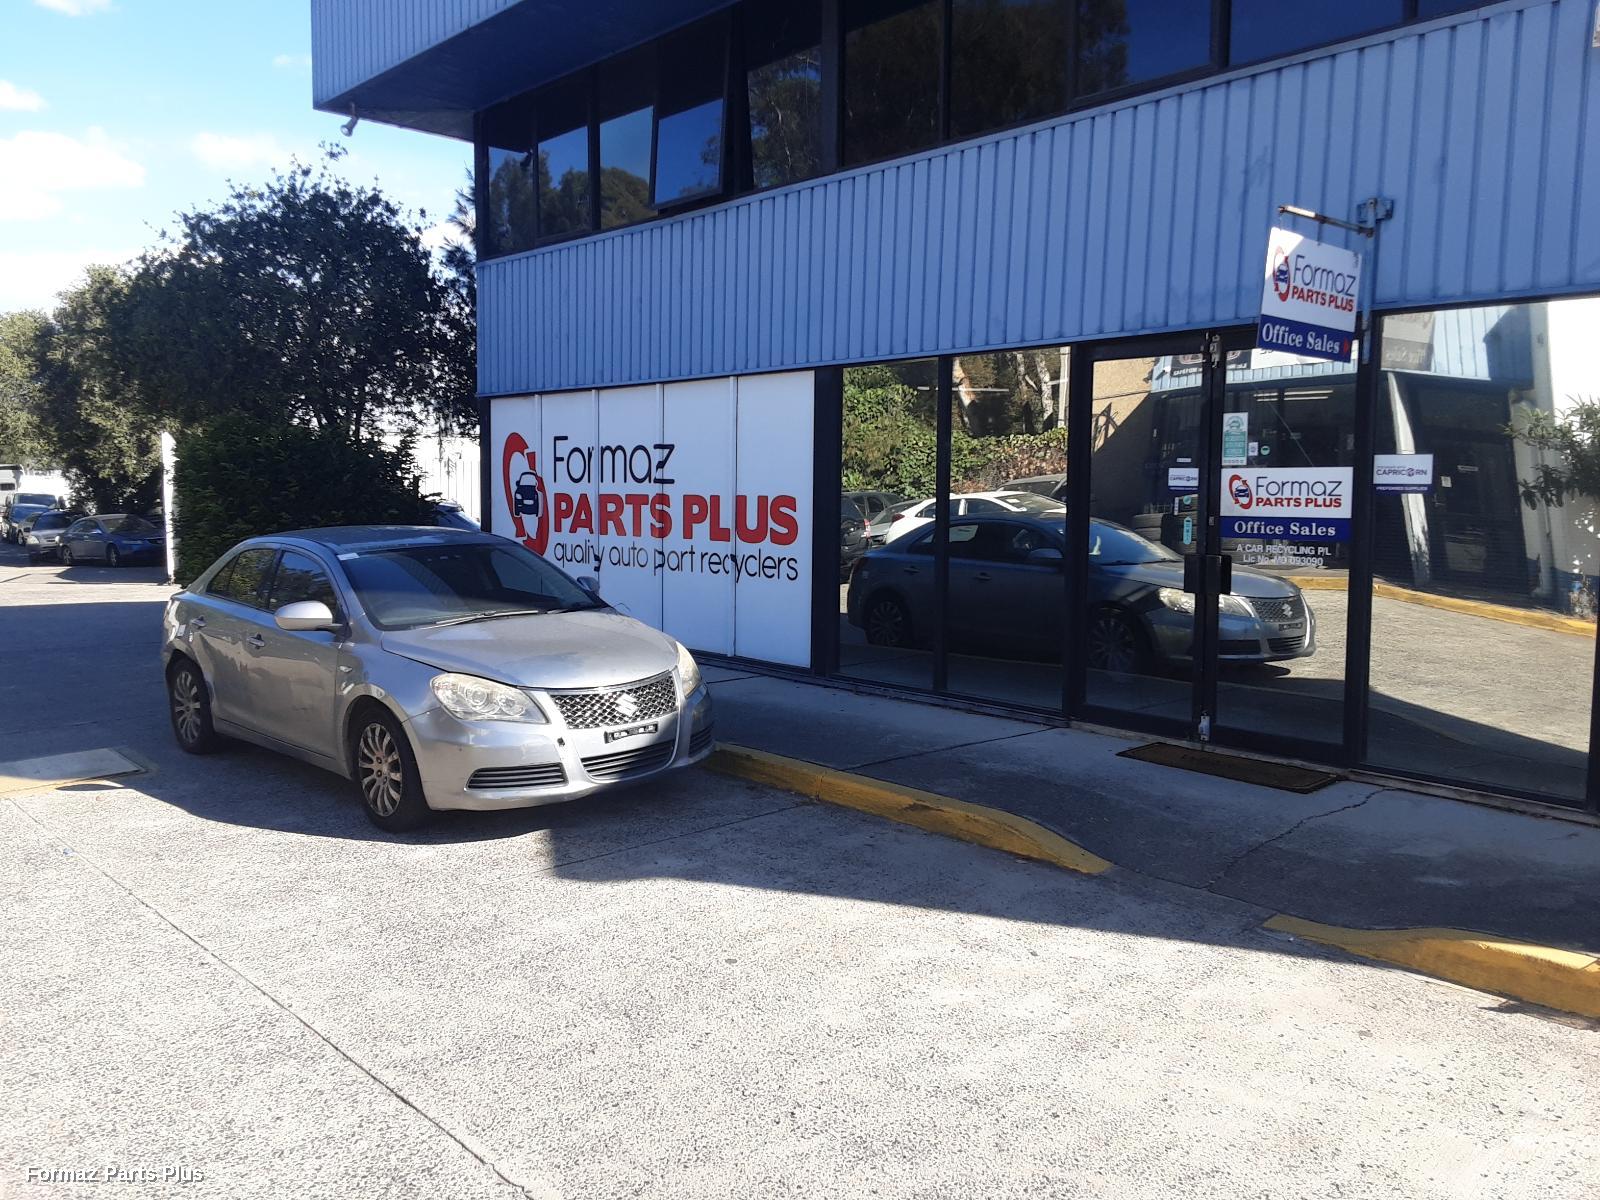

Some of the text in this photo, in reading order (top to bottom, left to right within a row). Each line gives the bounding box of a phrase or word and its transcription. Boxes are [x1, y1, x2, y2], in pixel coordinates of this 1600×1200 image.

[1293, 255, 1357, 297] Formaz
[1292, 286, 1354, 313] PARTS PLUS
[1262, 323, 1341, 354] Office Sales
[554, 436, 675, 484] Formaz
[1256, 476, 1343, 497] Formaz
[1256, 497, 1342, 508] PARTS PLUS
[554, 492, 799, 546] PARTS PLUS
[1234, 521, 1336, 536] Office Sales
[554, 539, 799, 583] qualiy auto part recyclers
[1236, 543, 1332, 556] A CAR RECYCLING P/L
